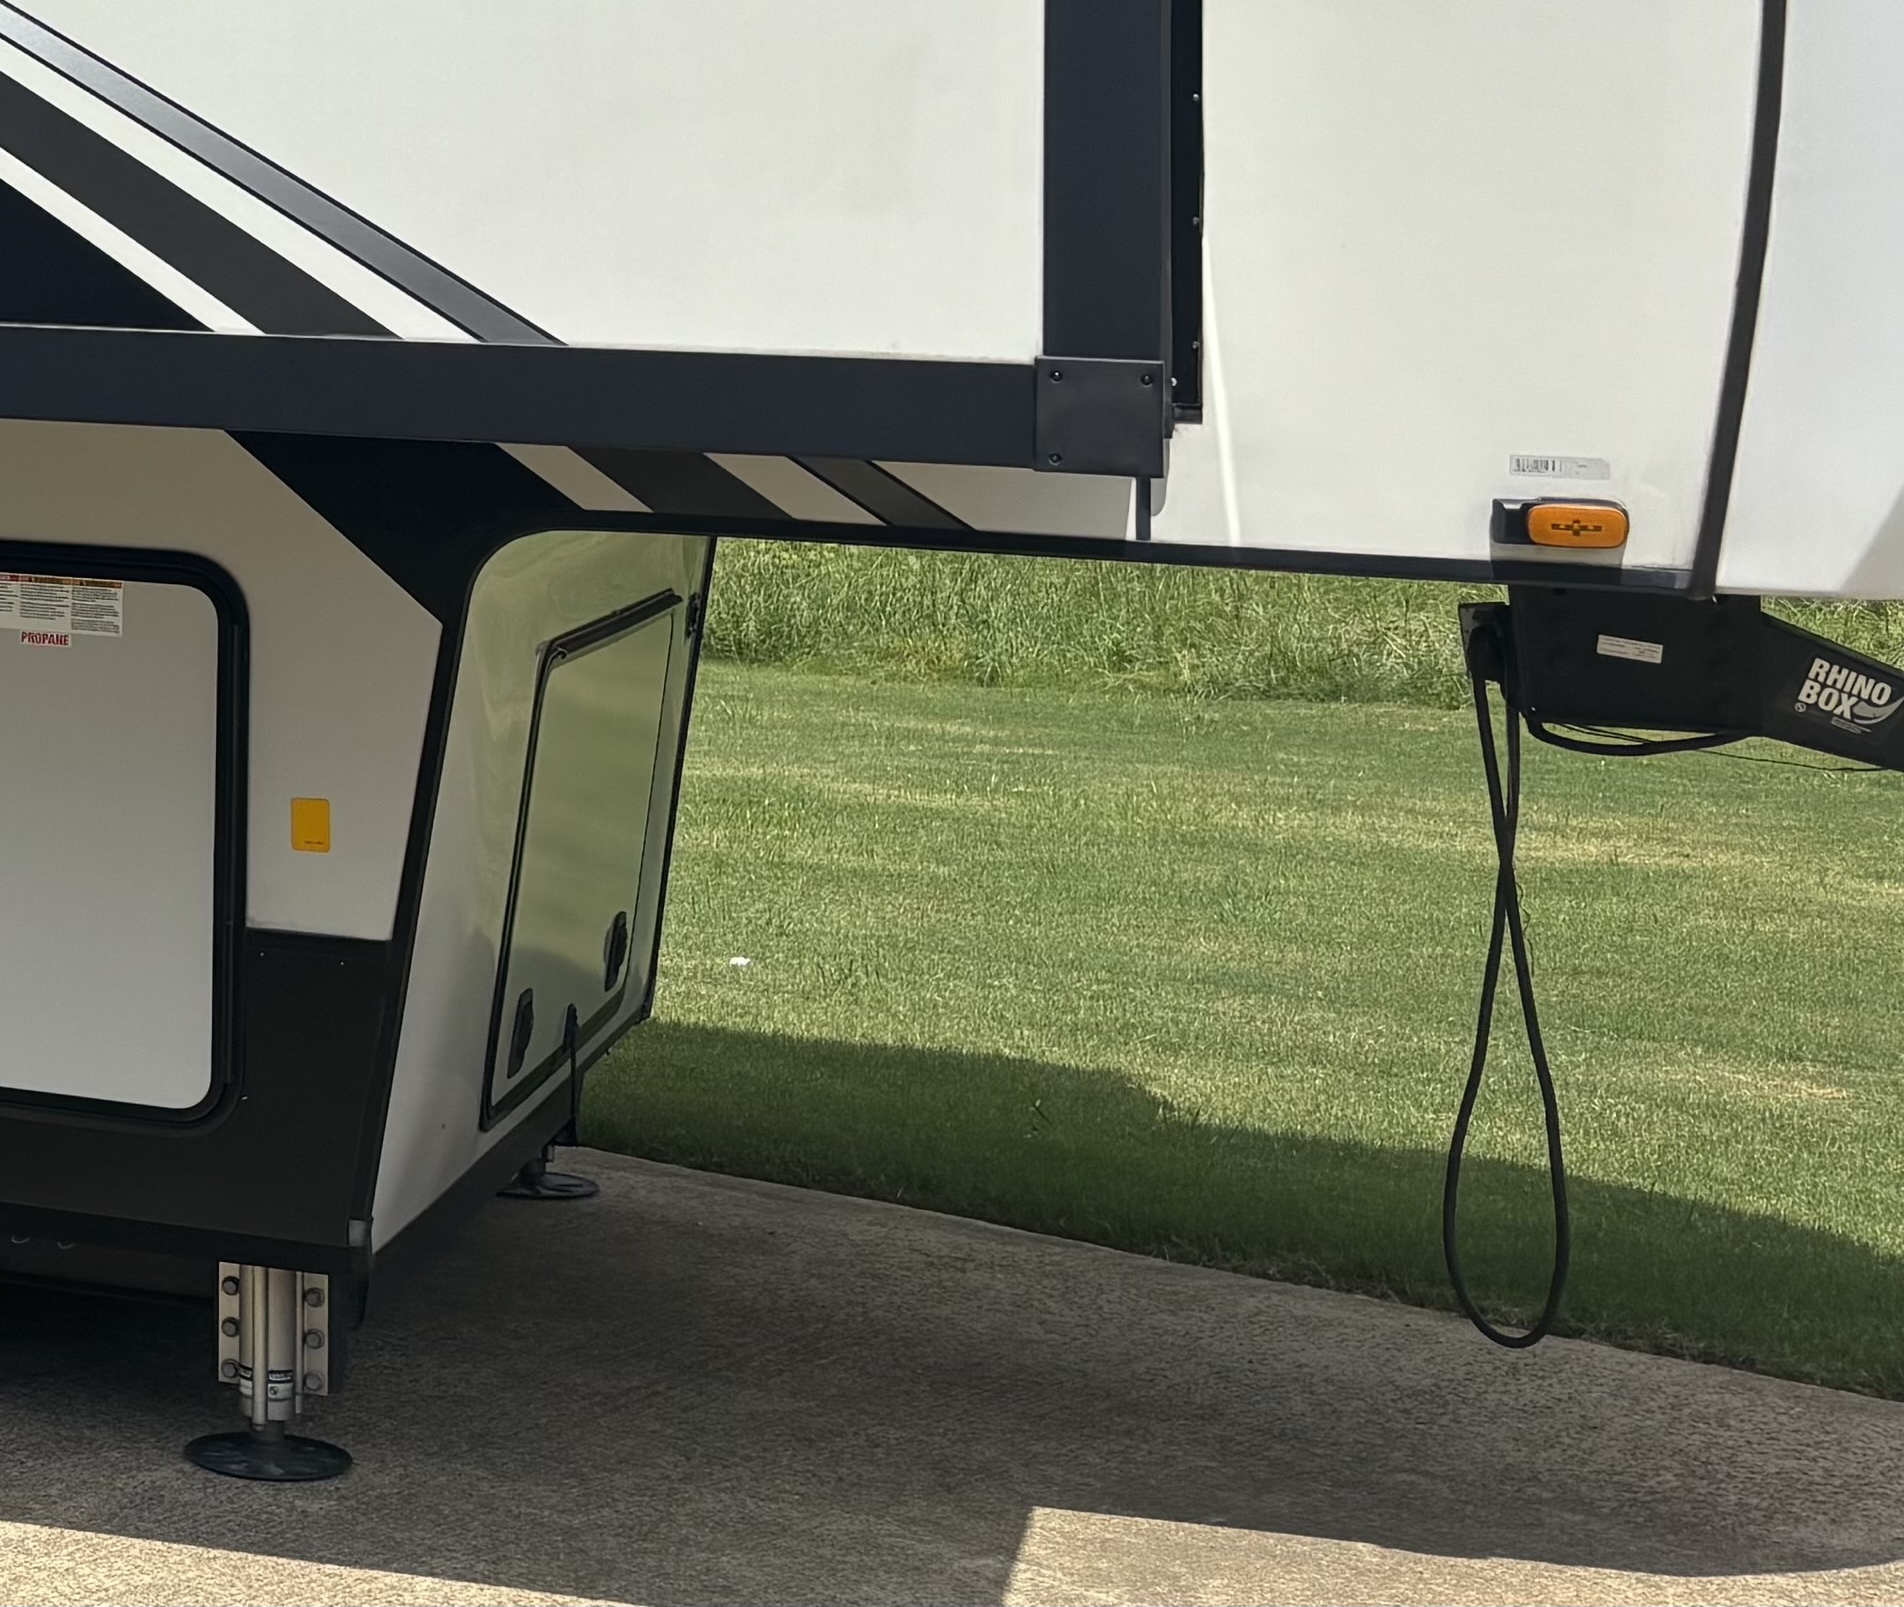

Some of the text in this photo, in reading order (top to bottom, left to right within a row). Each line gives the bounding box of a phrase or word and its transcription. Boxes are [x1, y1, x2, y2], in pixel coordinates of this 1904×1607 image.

[20, 631, 70, 646] PROPANE
[1797, 678, 1859, 720] BOX
[1807, 657, 1892, 706] RHINO
